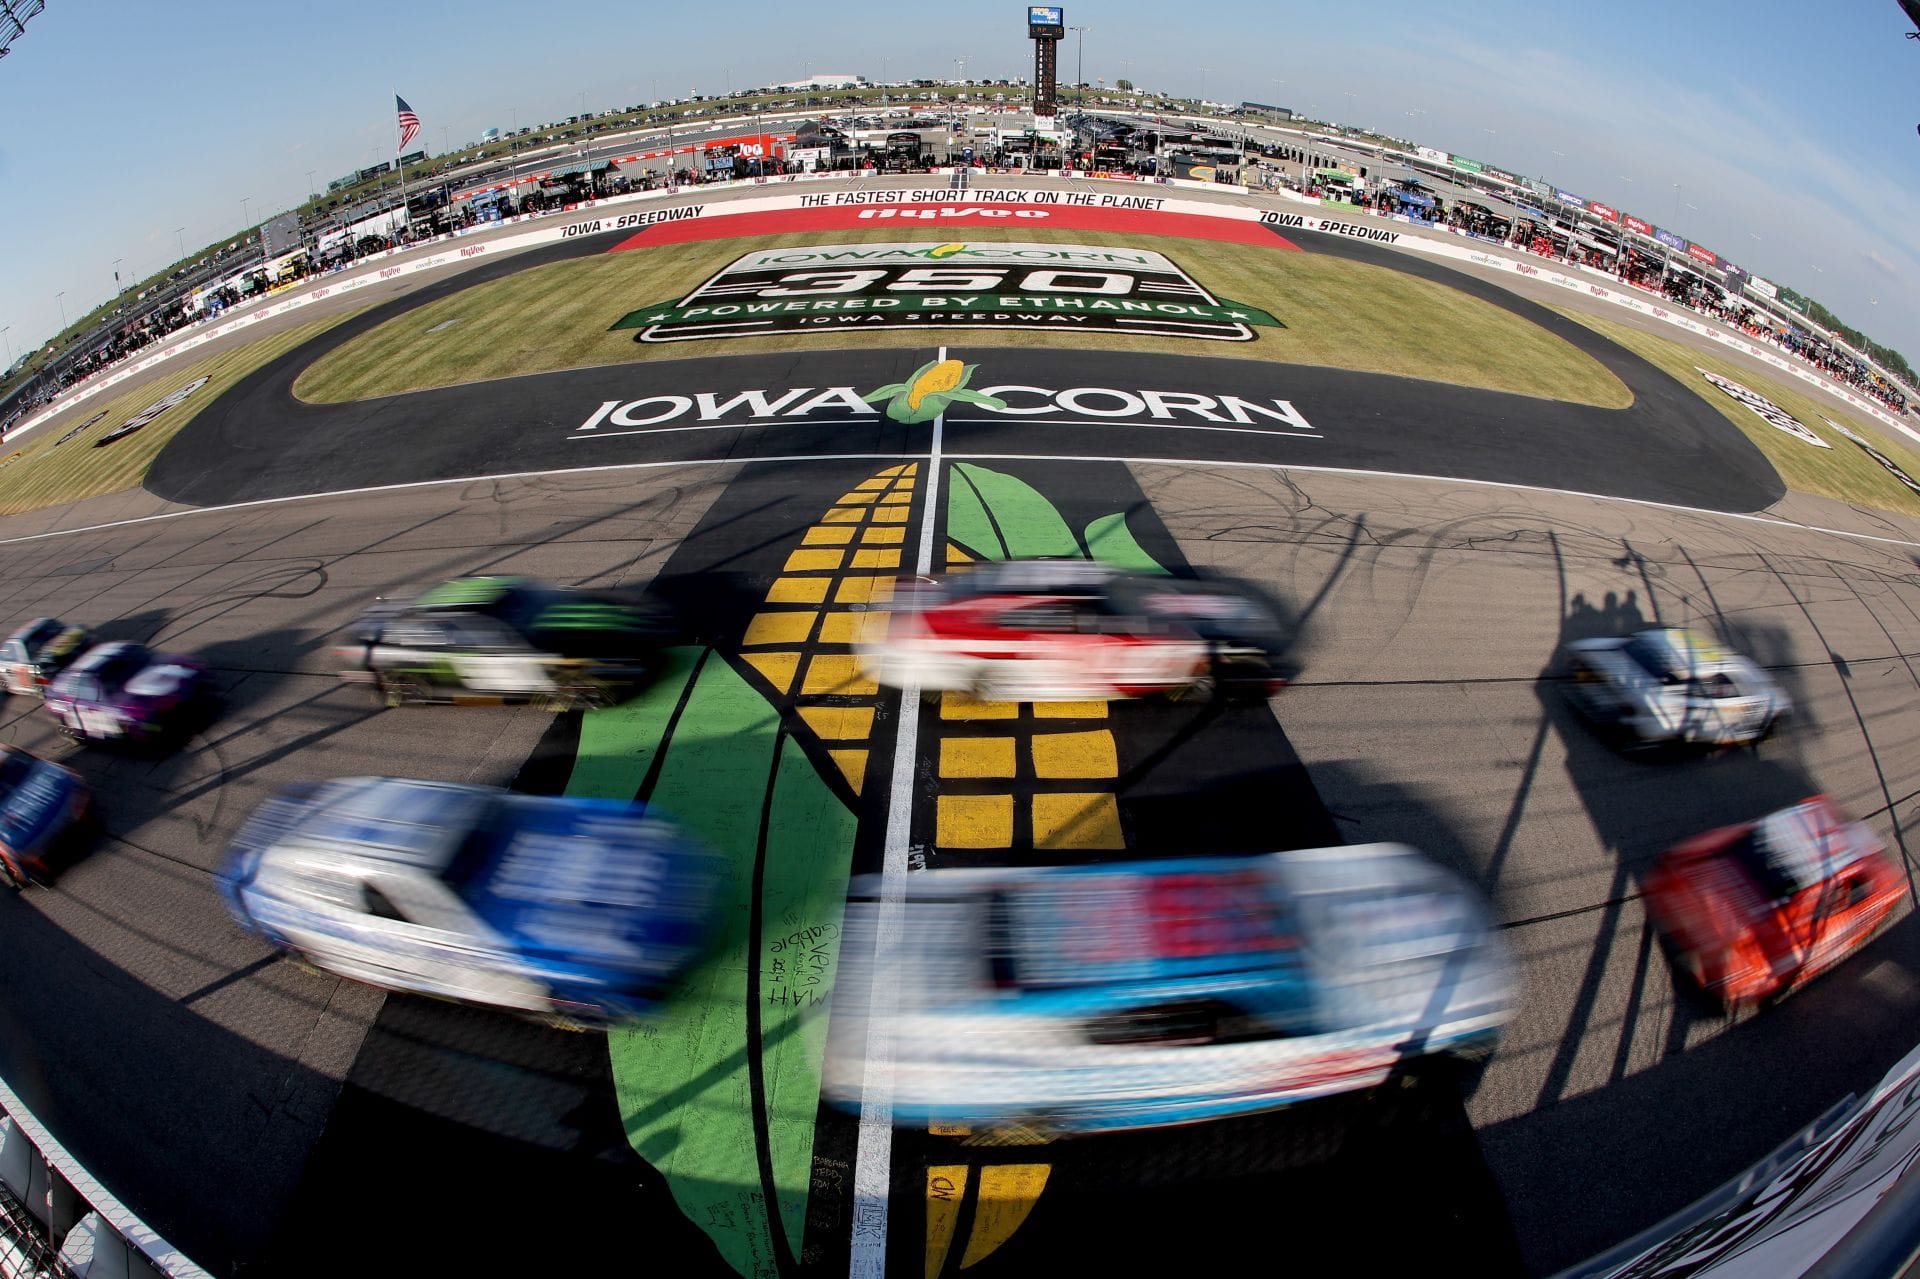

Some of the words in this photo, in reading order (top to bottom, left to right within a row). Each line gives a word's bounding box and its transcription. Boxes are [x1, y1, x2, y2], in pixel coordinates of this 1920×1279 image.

[800, 194, 830, 207] THE
[835, 190, 909, 205] FASTEST
[911, 190, 968, 202] SHORT
[974, 190, 1029, 203] TRACK
[1034, 191, 1060, 203] ON
[1065, 192, 1097, 206] THE
[1101, 194, 1165, 210] PLANET
[560, 220, 601, 238] IOWA
[616, 205, 704, 229] SPEEDWAY
[1260, 210, 1304, 228] IOWA
[1318, 220, 1400, 244] SPEEDWAY
[460, 244, 485, 257] HyVee
[757, 249, 918, 266] IOWA
[974, 249, 1150, 265] CORN
[1516, 263, 1538, 276] HyVee
[757, 268, 1135, 297] 350
[681, 298, 901, 320] POWERED
[922, 296, 979, 307] BY
[999, 297, 1213, 317] ETHANOL
[799, 314, 885, 324] IOWA
[905, 313, 1088, 323] SPEEDWAY
[576, 387, 881, 431] IOWA
[973, 385, 1315, 429] CORN
